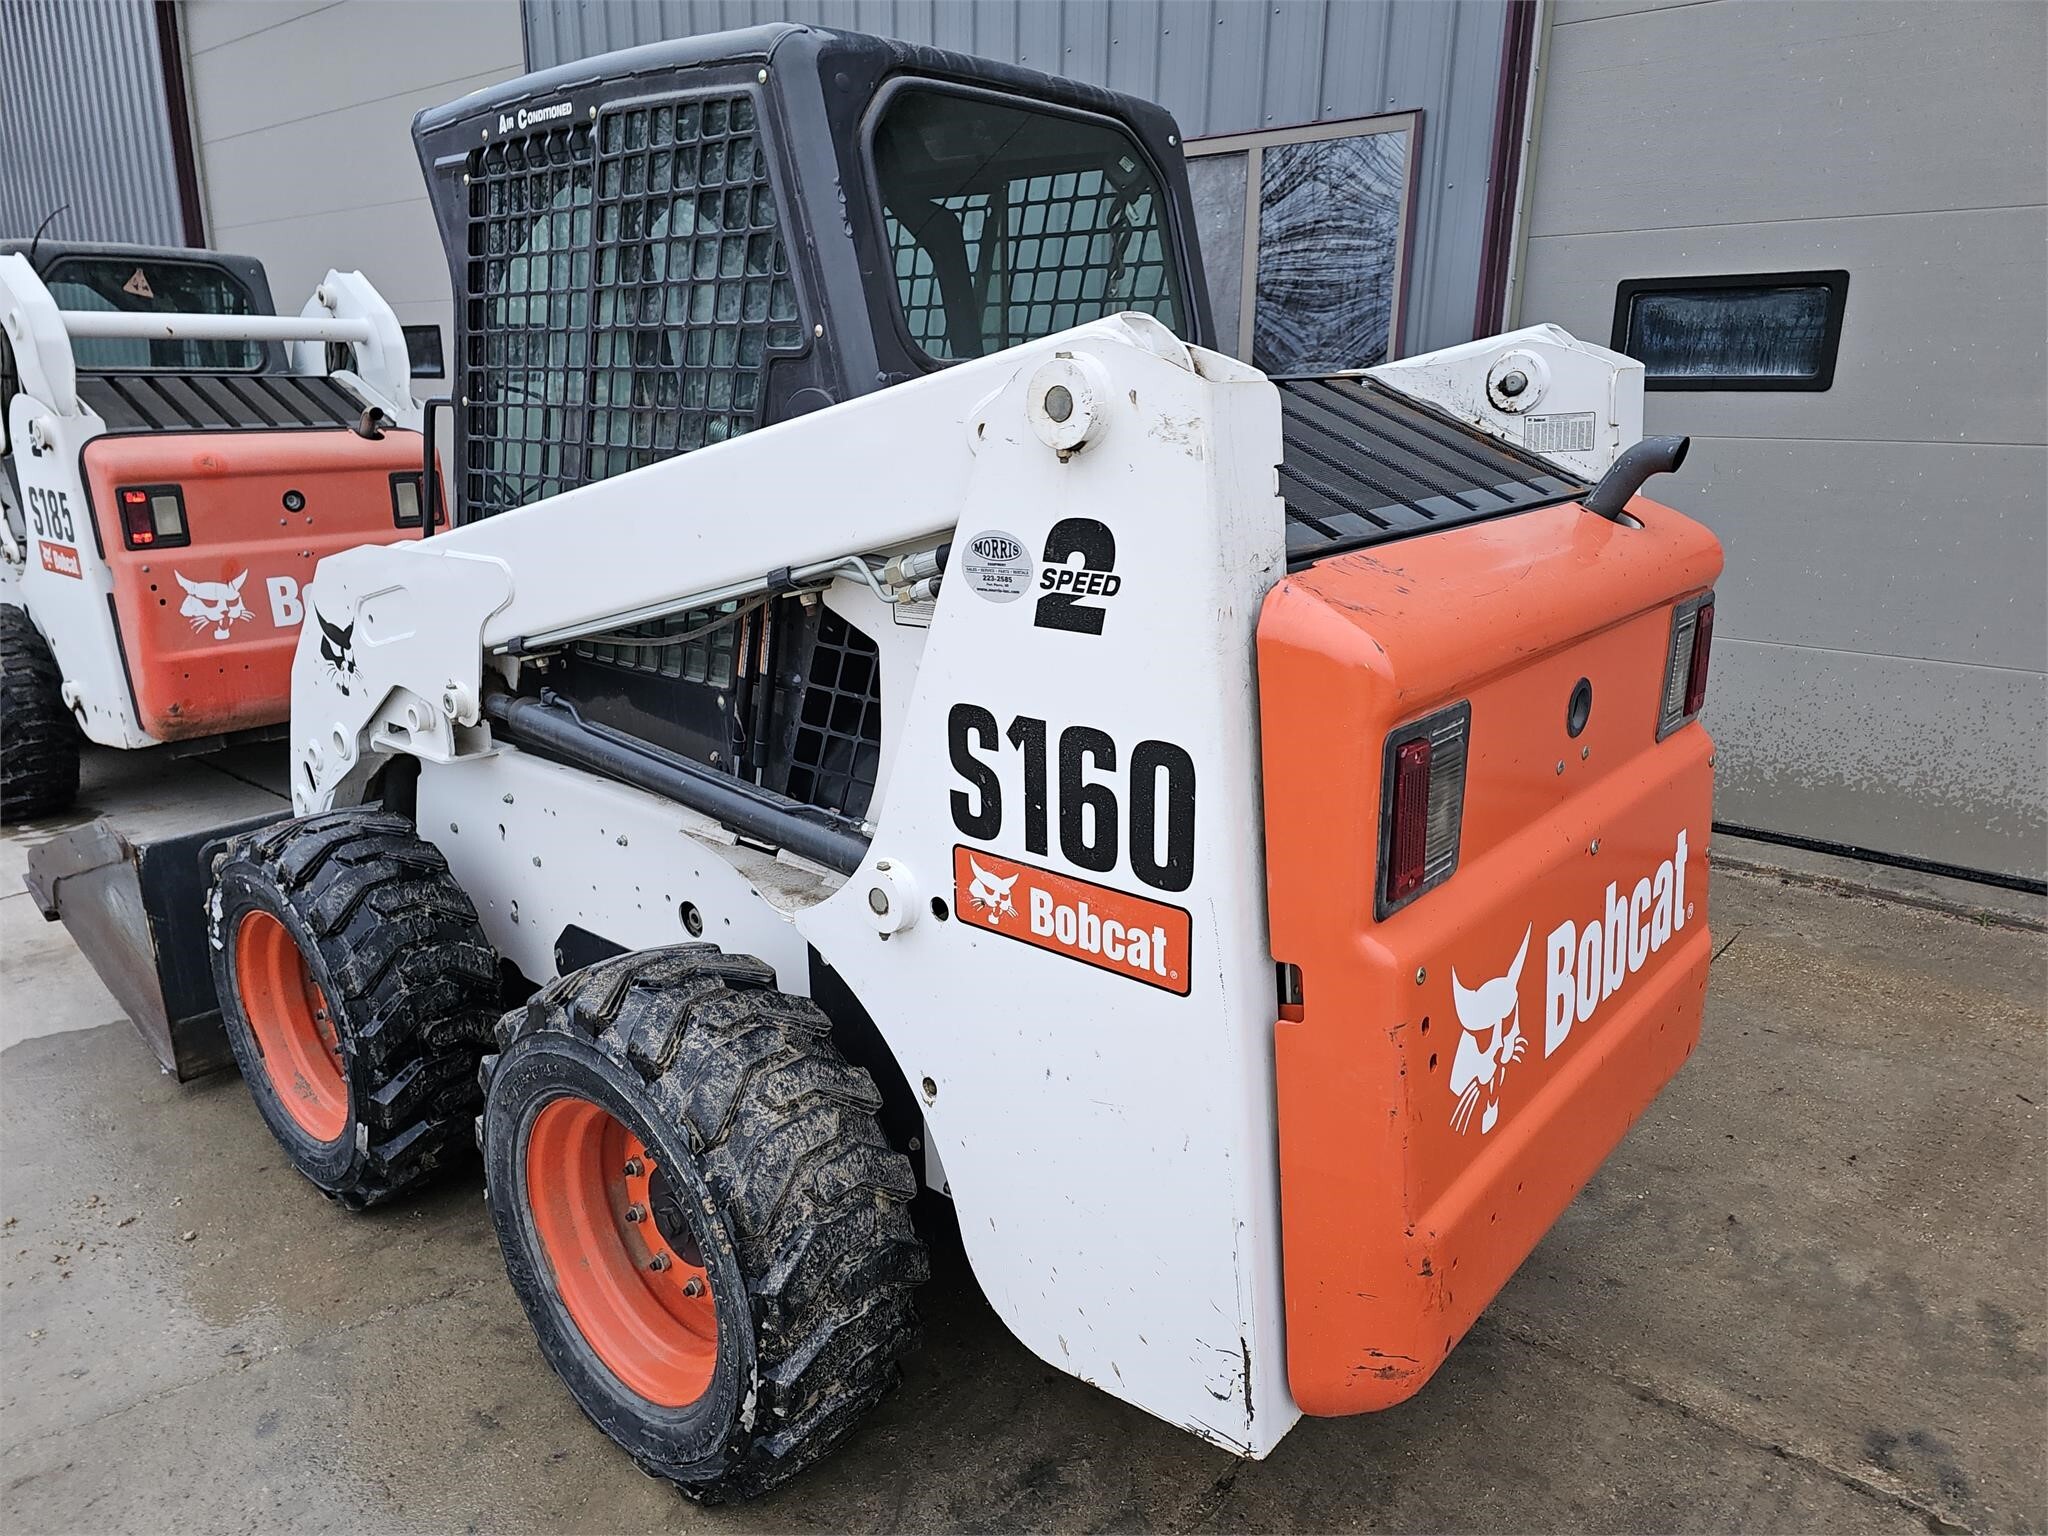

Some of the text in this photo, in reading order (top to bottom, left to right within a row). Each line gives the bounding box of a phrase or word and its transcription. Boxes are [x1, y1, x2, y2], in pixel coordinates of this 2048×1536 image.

[28, 486, 75, 543] S185
[974, 539, 1020, 559] MORRIS
[982, 574, 1013, 583] 223-2585
[1034, 517, 1116, 636] 2
[1040, 568, 1121, 597] SPEED
[948, 702, 1196, 893] S160
[1029, 886, 1168, 977] Bobcat
[1544, 828, 1688, 1060] Bobcat
